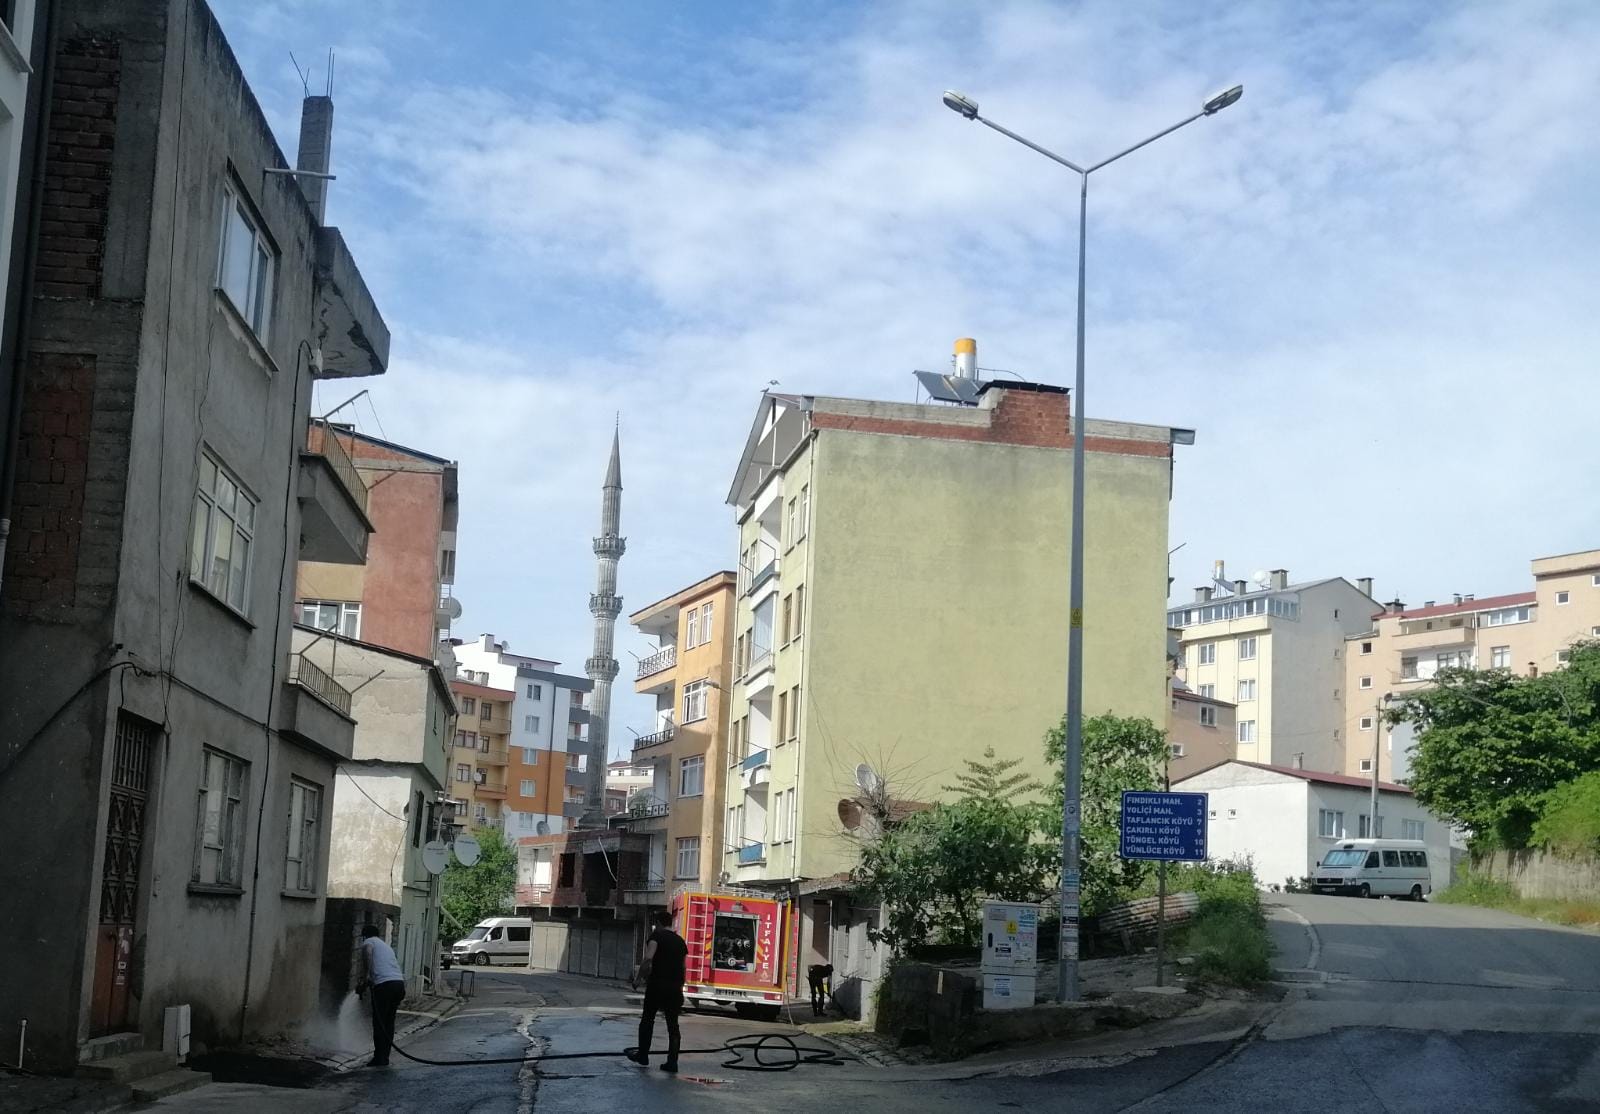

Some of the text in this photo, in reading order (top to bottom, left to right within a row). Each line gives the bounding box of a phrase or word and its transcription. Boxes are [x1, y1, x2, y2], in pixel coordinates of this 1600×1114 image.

[1126, 835, 1156, 843] TÖNGEL
[1159, 836, 1179, 845] KÖYÜ
[1126, 845, 1161, 854] YÜNLÜCE
